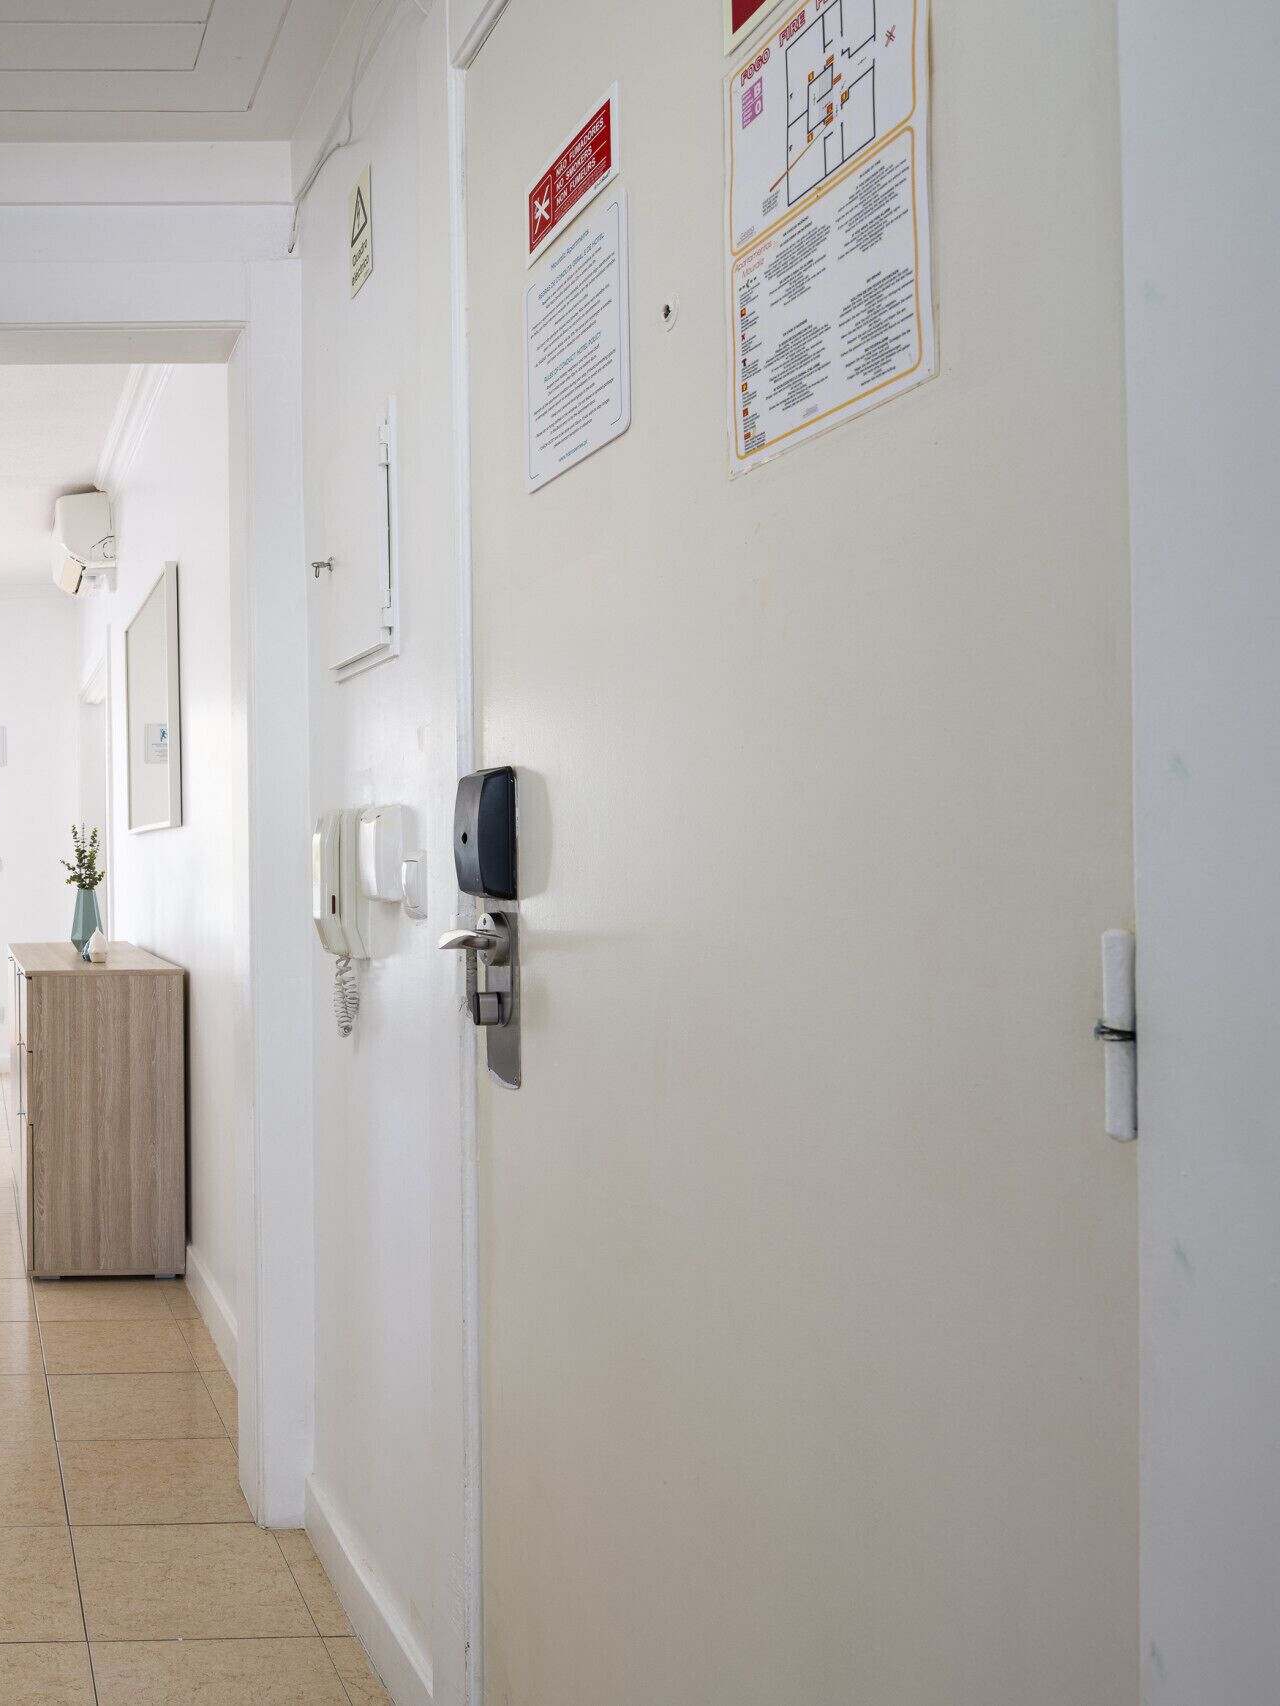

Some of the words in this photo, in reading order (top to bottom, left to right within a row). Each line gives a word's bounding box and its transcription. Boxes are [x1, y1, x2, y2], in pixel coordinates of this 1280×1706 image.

[741, 48, 770, 87] FOGO
[779, 10, 805, 47] FIRE
[556, 158, 567, 178] NÃO
[569, 117, 604, 162] FUMADORES
[556, 178, 564, 192] NO
[566, 145, 592, 180] SMOKERS
[556, 188, 567, 206] NON
[569, 157, 596, 191] FUMEURS
[353, 239, 367, 266] Quadro
